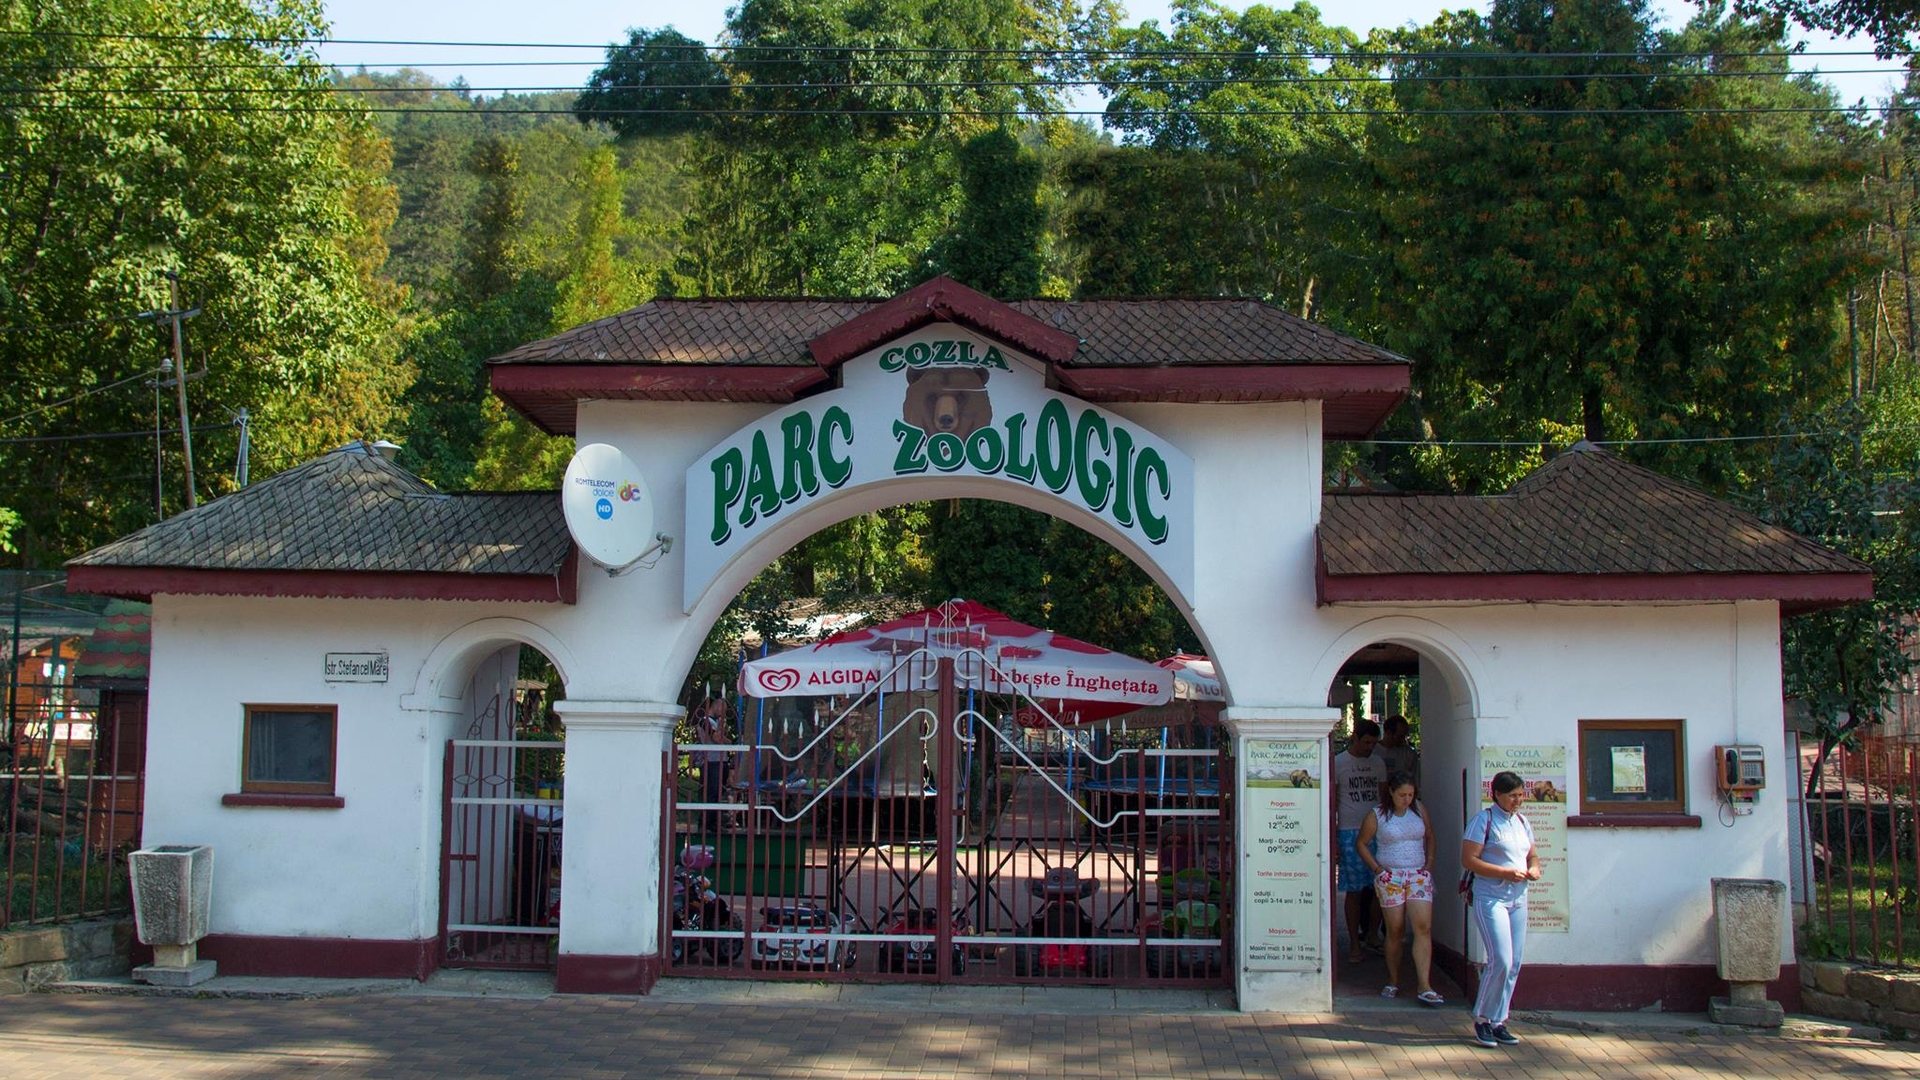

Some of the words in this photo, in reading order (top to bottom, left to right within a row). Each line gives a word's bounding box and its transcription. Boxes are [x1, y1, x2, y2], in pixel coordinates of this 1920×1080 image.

[879, 340, 1013, 373] COZLA
[710, 406, 854, 546] PARC
[892, 398, 1171, 545] ZOOLOGIC
[575, 478, 615, 488] ROMTELECOM
[370, 660, 387, 675] Mare
[808, 669, 879, 685] ALGIDA
[1250, 751, 1271, 759] PARC
[1506, 749, 1540, 757] COZLA
[1484, 760, 1509, 768] PARC
[1349, 791, 1361, 802] TO
